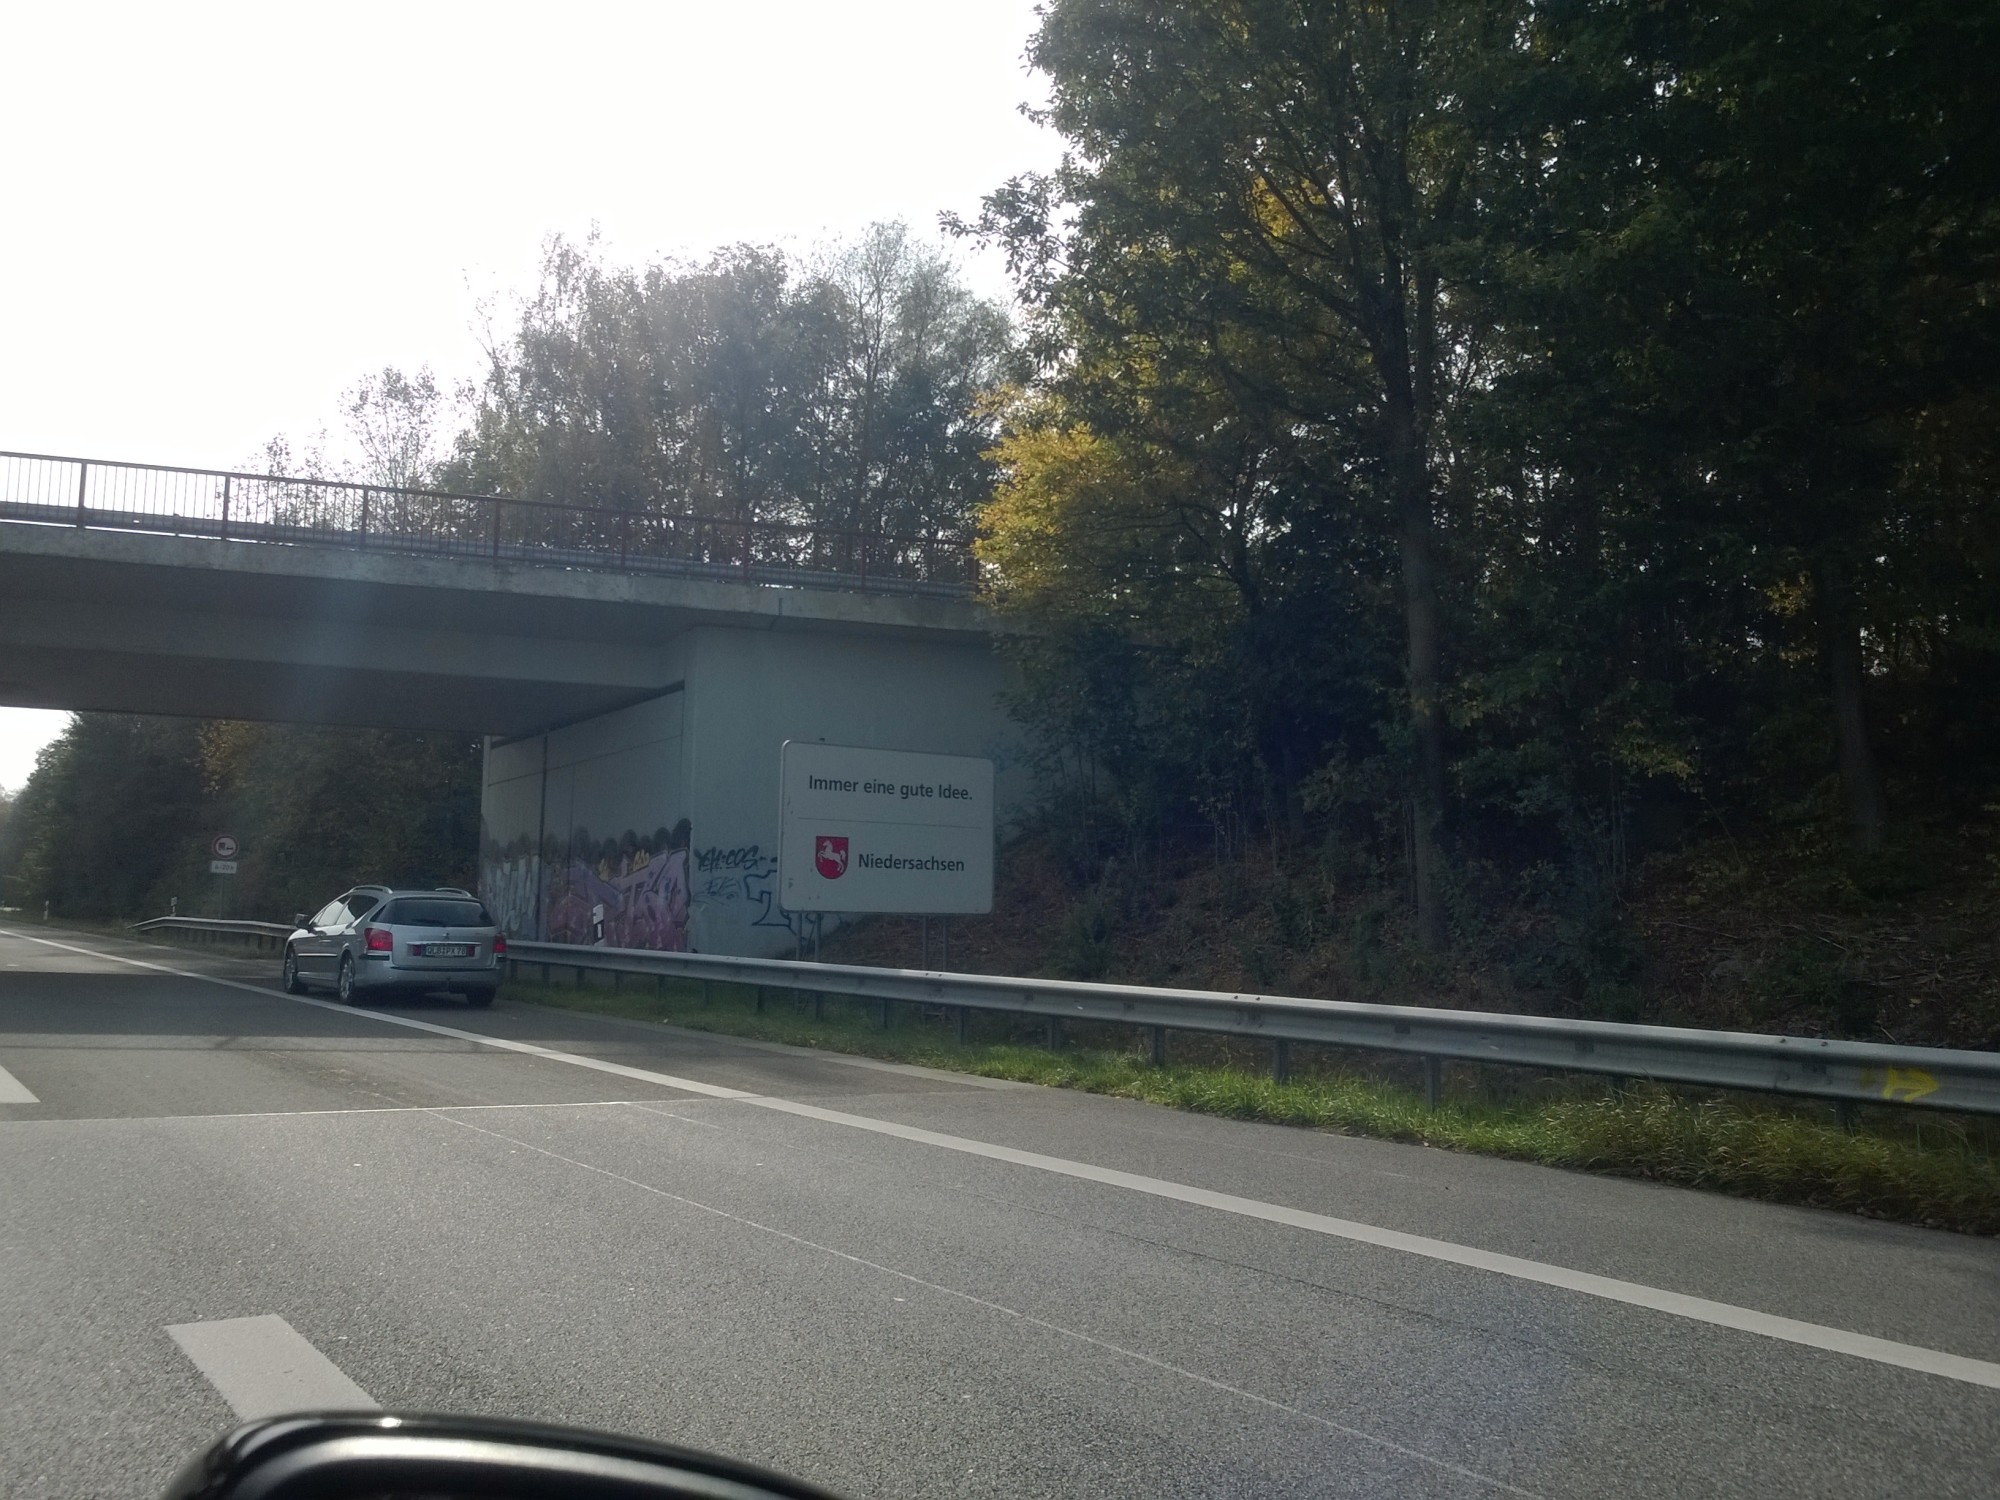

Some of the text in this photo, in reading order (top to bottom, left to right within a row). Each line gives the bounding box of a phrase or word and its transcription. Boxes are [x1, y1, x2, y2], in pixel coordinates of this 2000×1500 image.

[809, 775, 973, 800] Immer eine gute Idee.
[858, 853, 965, 872] Niedersachsen
